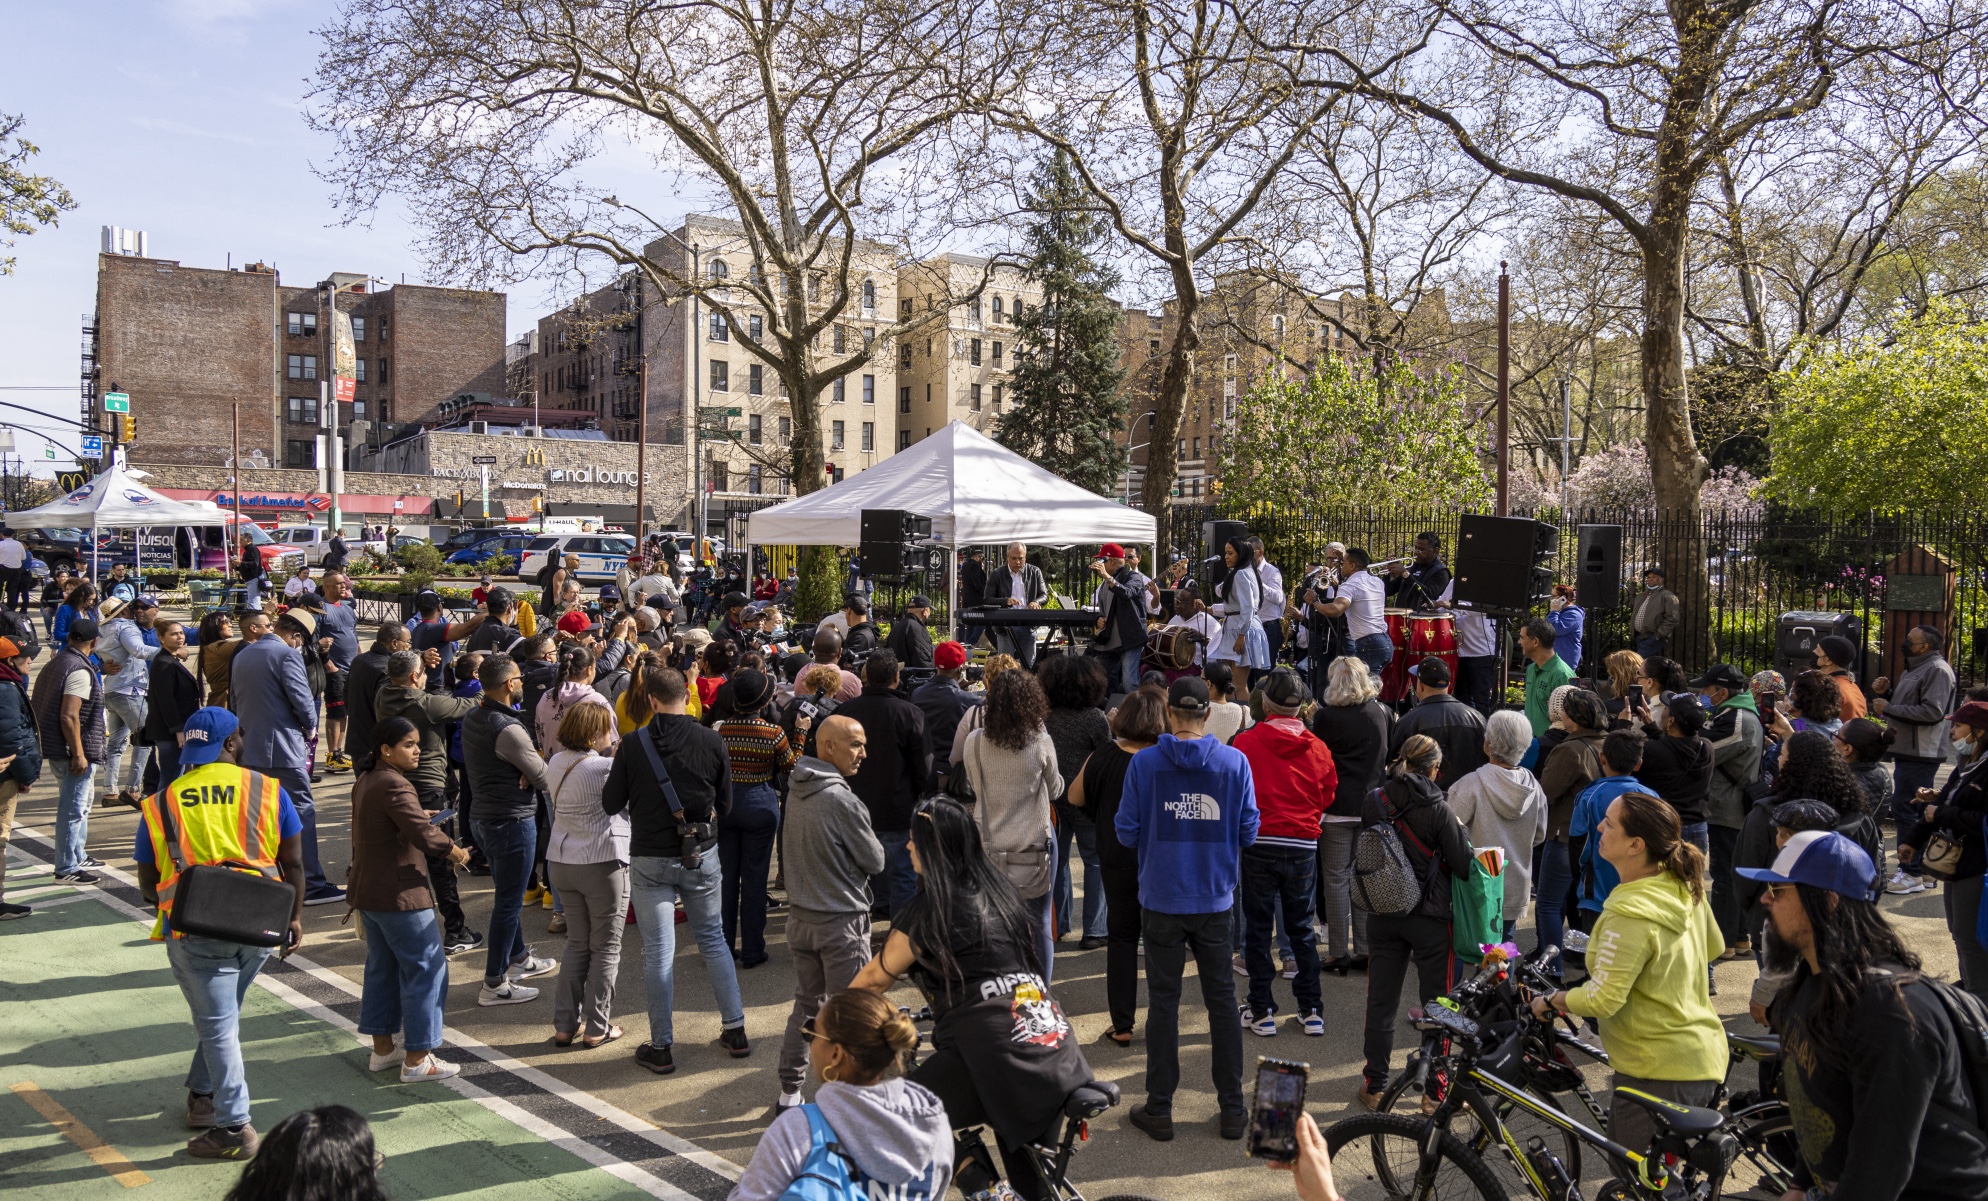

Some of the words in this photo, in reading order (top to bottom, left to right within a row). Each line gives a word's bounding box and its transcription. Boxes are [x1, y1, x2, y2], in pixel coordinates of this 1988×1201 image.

[432, 467, 460, 477] FACE
[566, 465, 592, 483] nail
[596, 465, 651, 487] lounge
[503, 481, 547, 490] McDonald's
[217, 494, 248, 506] Bak
[247, 495, 259, 506] of
[259, 496, 306, 508] America
[603, 561, 627, 572] NYP
[180, 785, 235, 808] SIM
[1180, 793, 1201, 802] THE
[1164, 801, 1201, 811] NORTH
[1175, 810, 1201, 820] FACE
